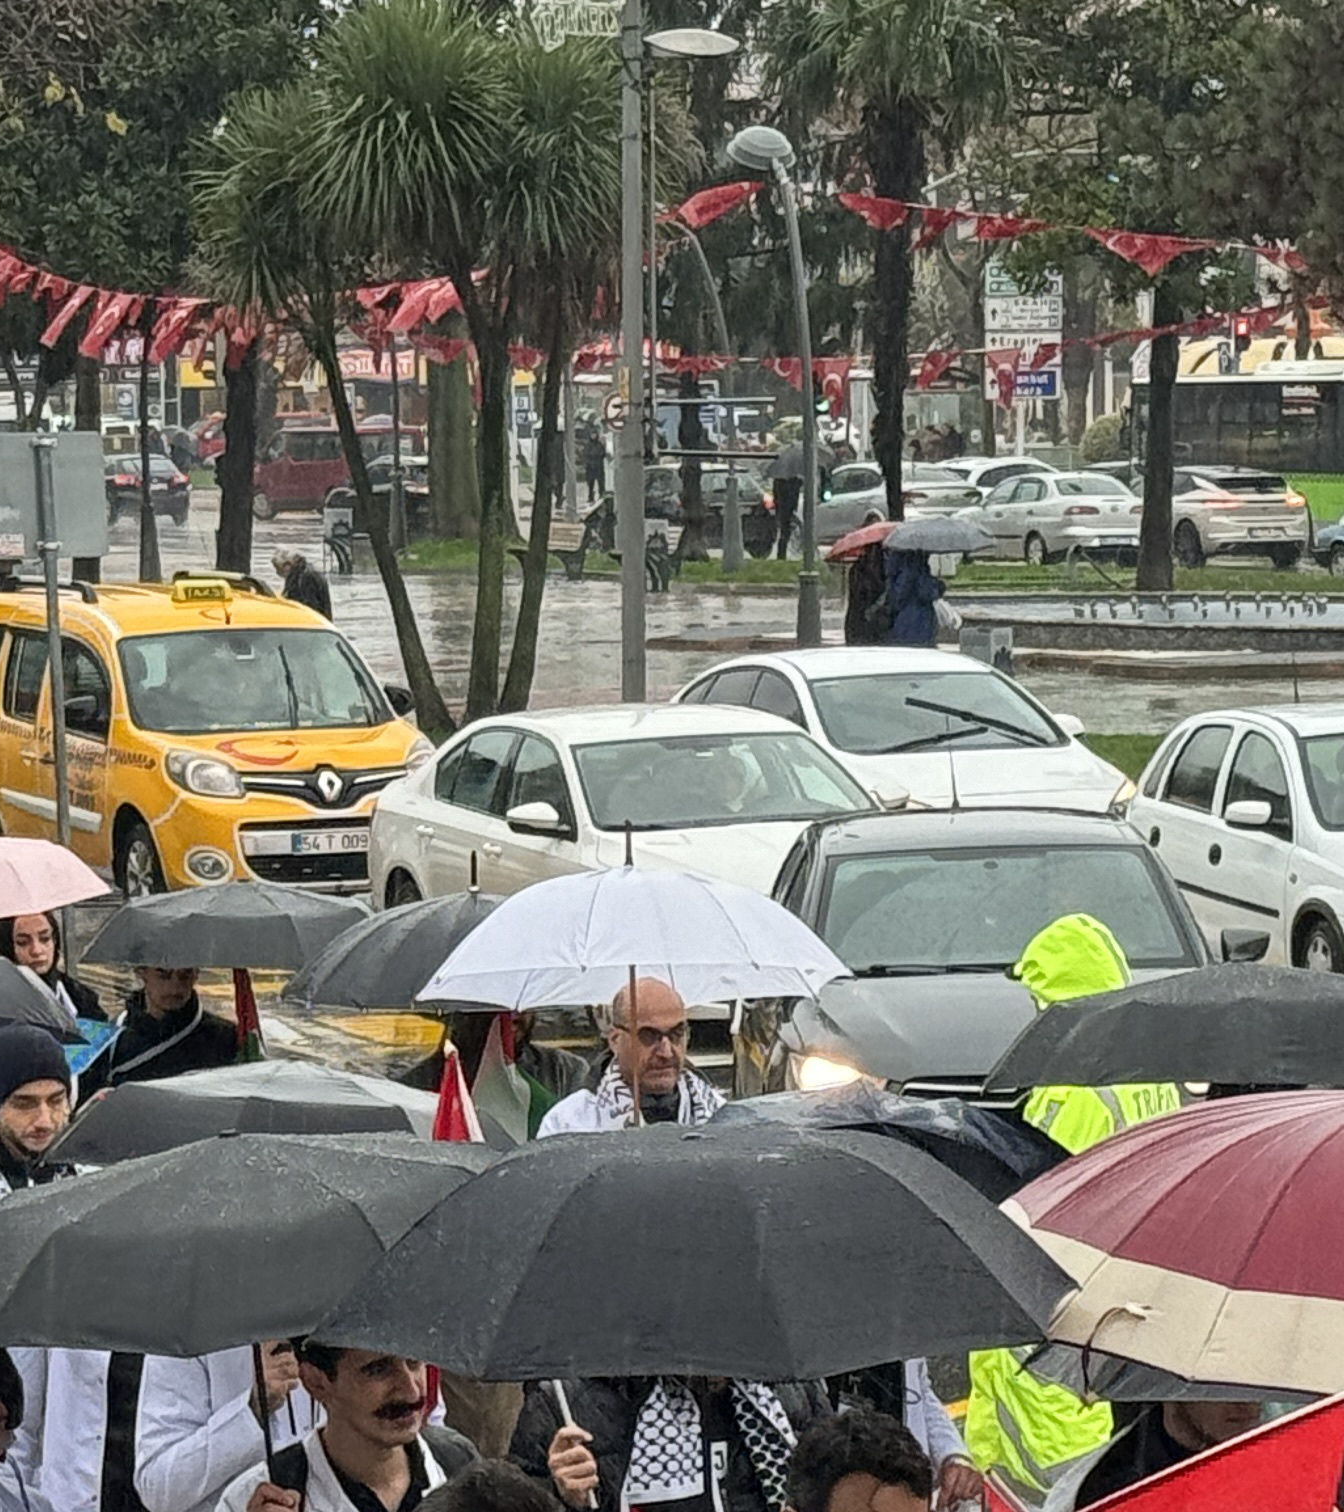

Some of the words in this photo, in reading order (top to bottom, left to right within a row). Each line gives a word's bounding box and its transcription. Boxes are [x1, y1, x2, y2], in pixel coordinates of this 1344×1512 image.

[302, 835, 320, 851] 54
[325, 834, 335, 849] T
[341, 834, 368, 849] 009
